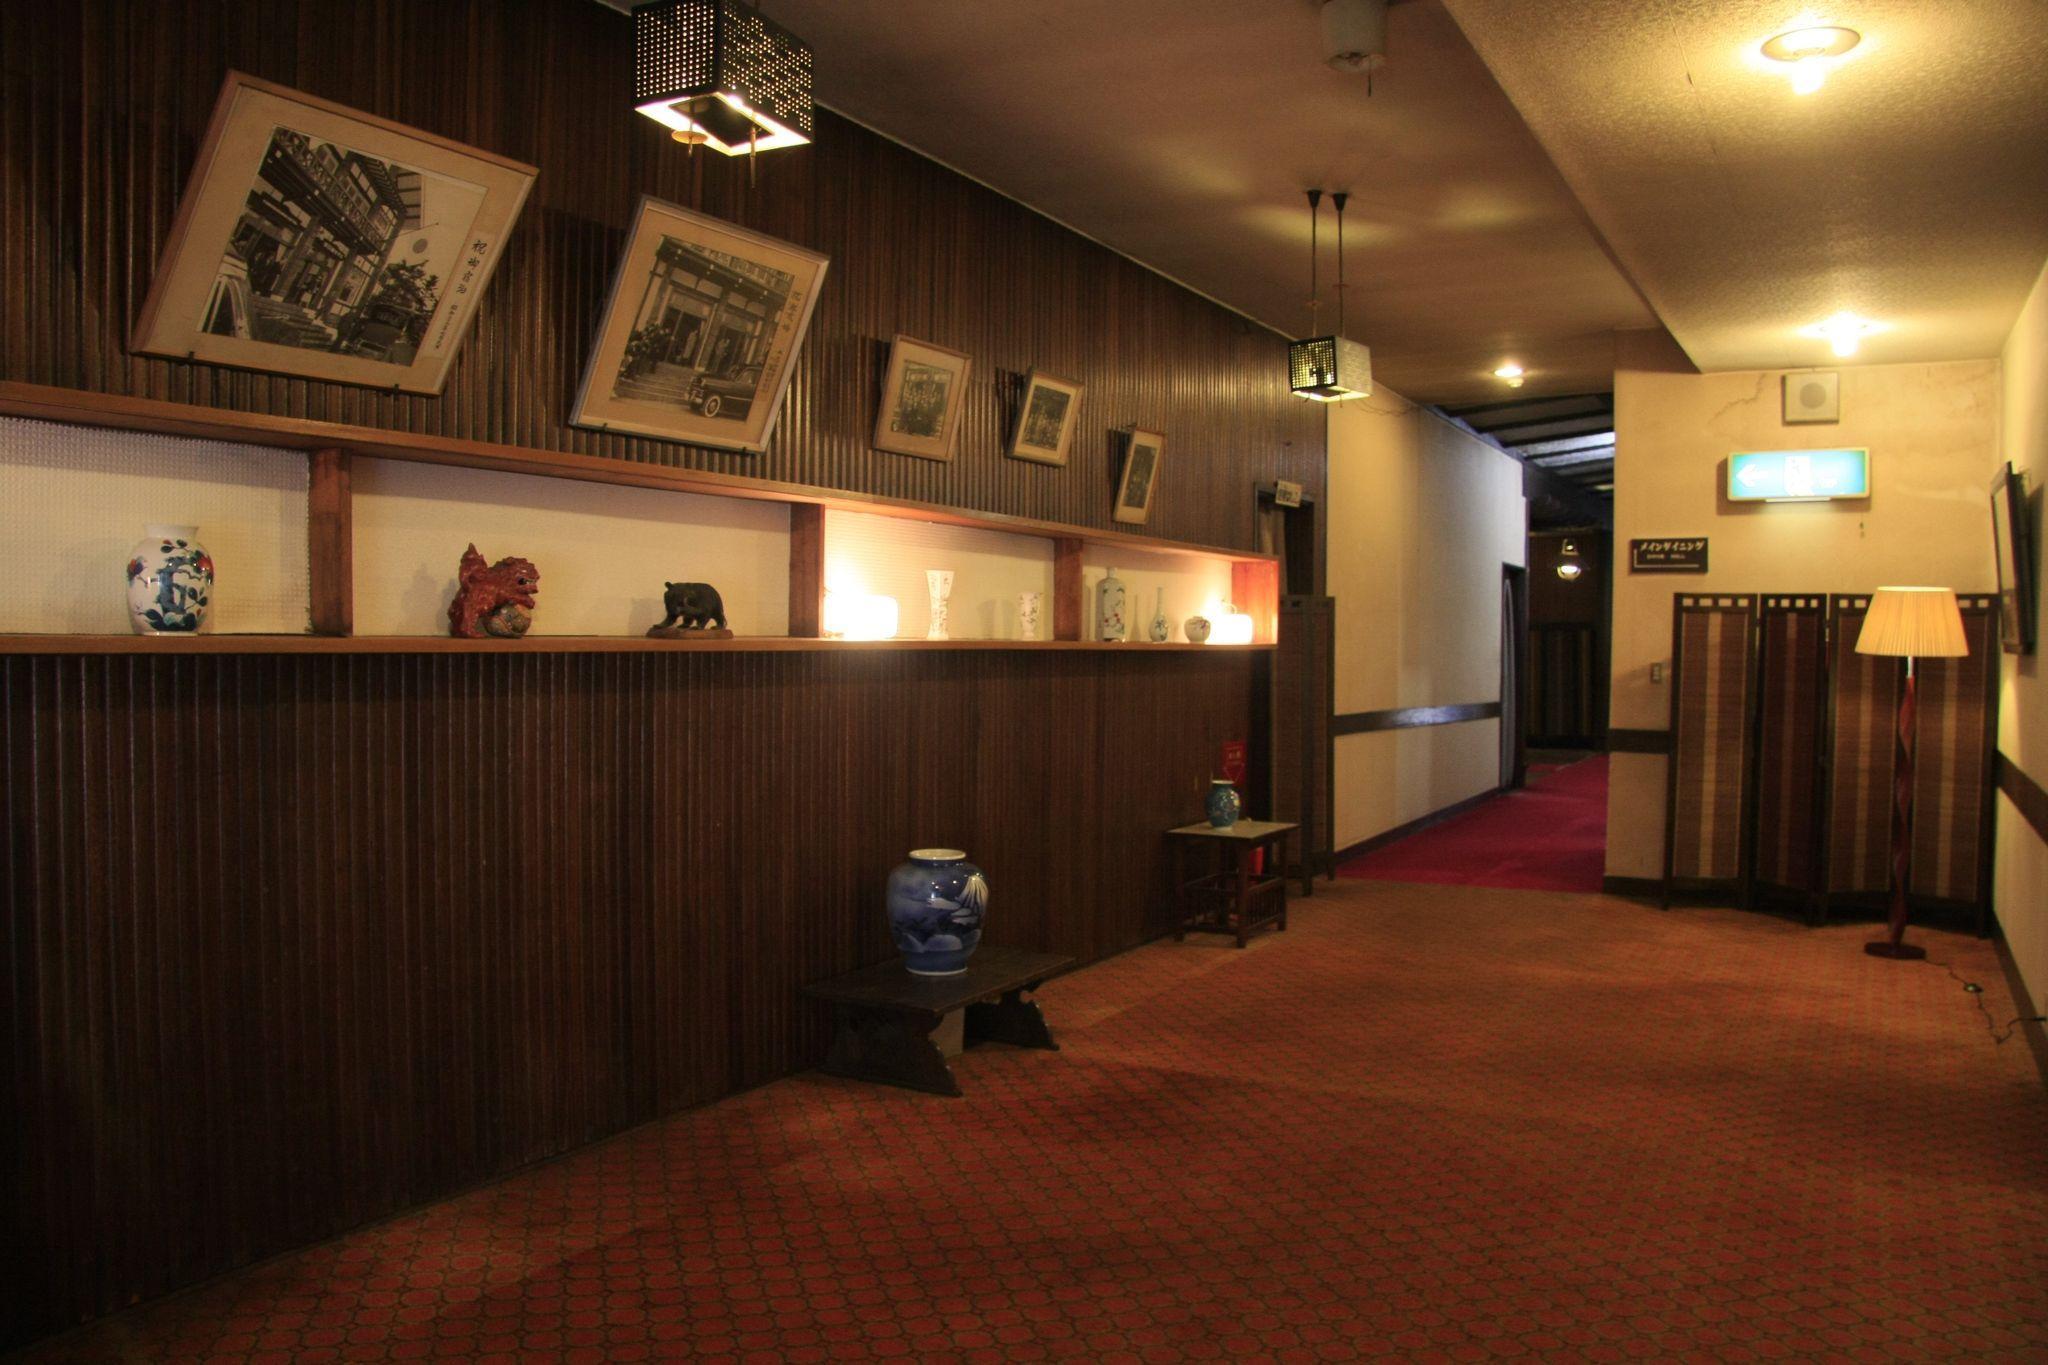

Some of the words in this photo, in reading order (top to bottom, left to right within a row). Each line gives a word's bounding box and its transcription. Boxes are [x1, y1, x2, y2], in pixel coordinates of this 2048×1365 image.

[1640, 541, 1705, 552] メインダイニング
